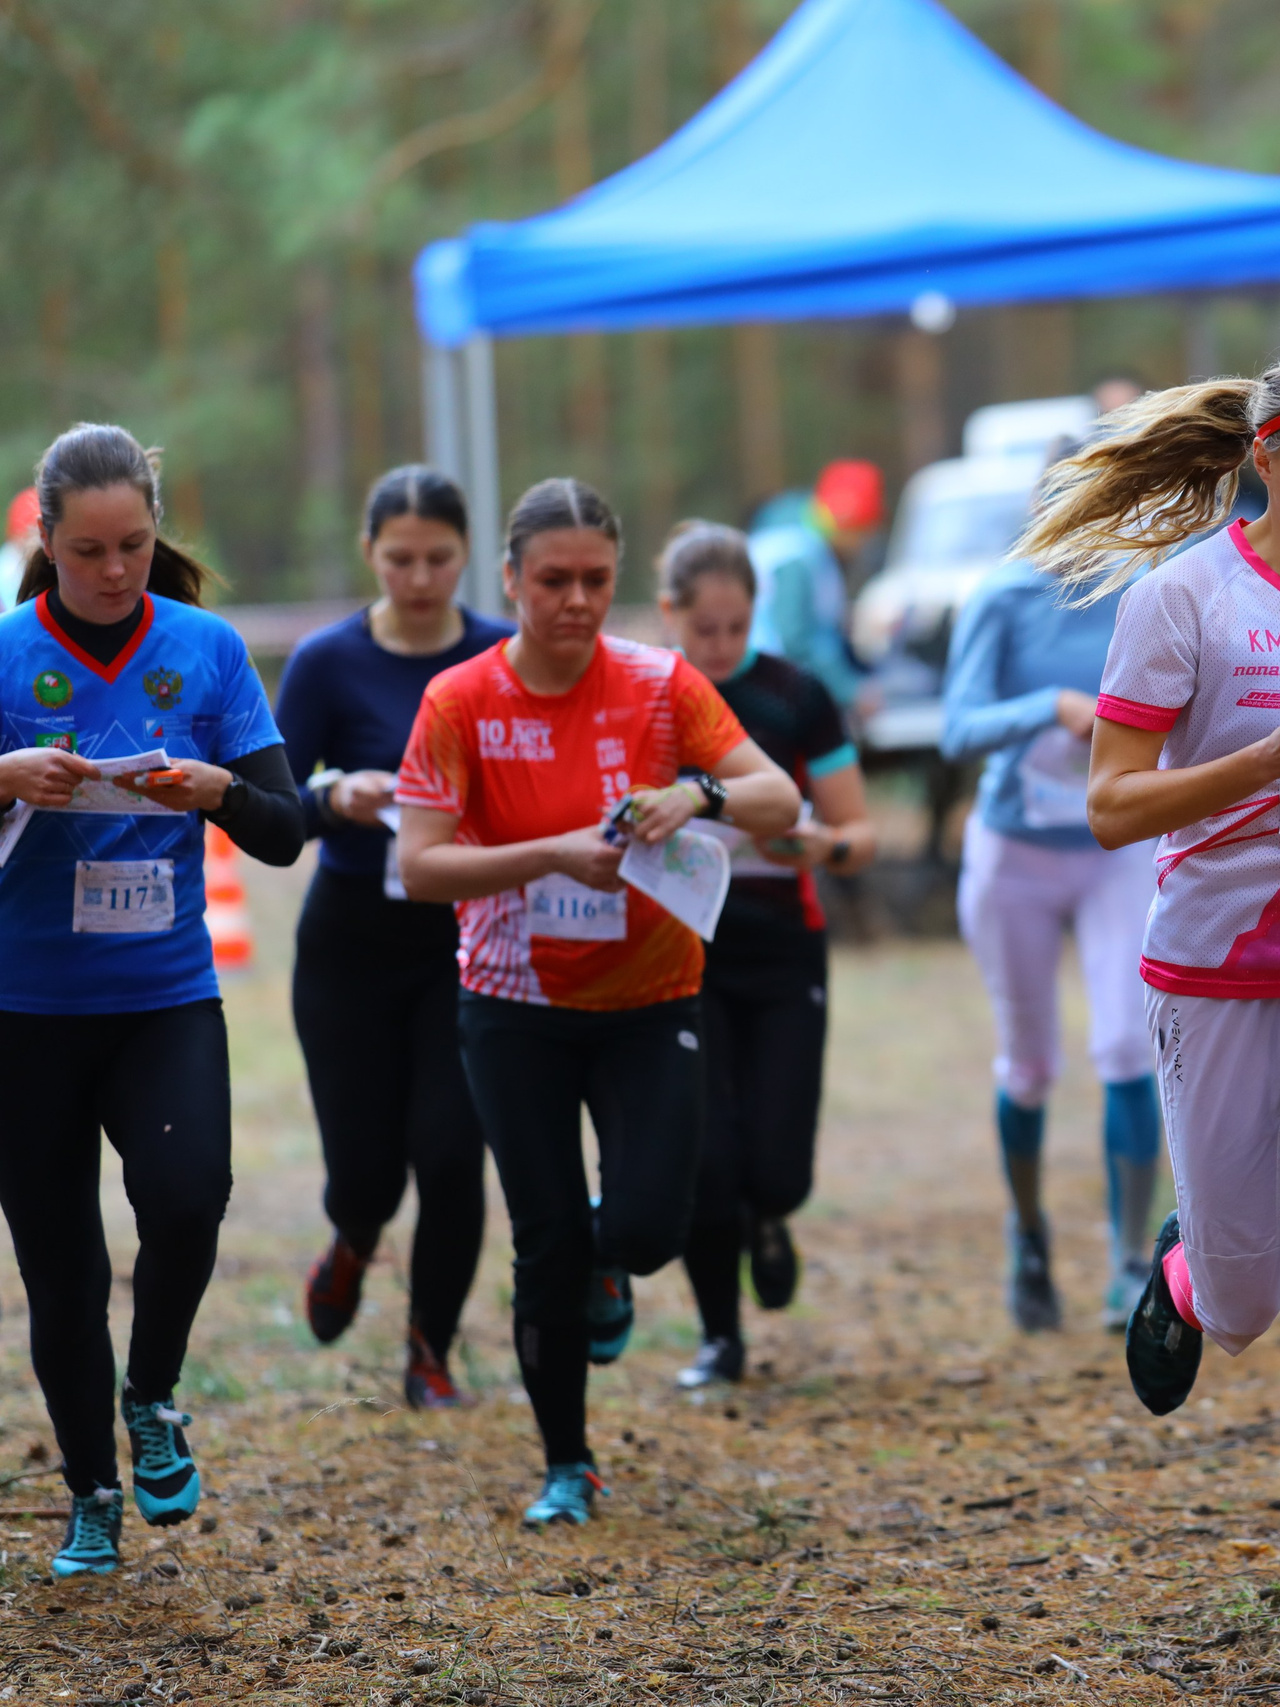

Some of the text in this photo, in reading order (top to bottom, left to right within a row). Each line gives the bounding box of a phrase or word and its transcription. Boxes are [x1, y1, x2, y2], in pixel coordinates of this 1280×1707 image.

[477, 718, 506, 746] 10
[110, 887, 148, 910] 117
[558, 897, 597, 919] 116
